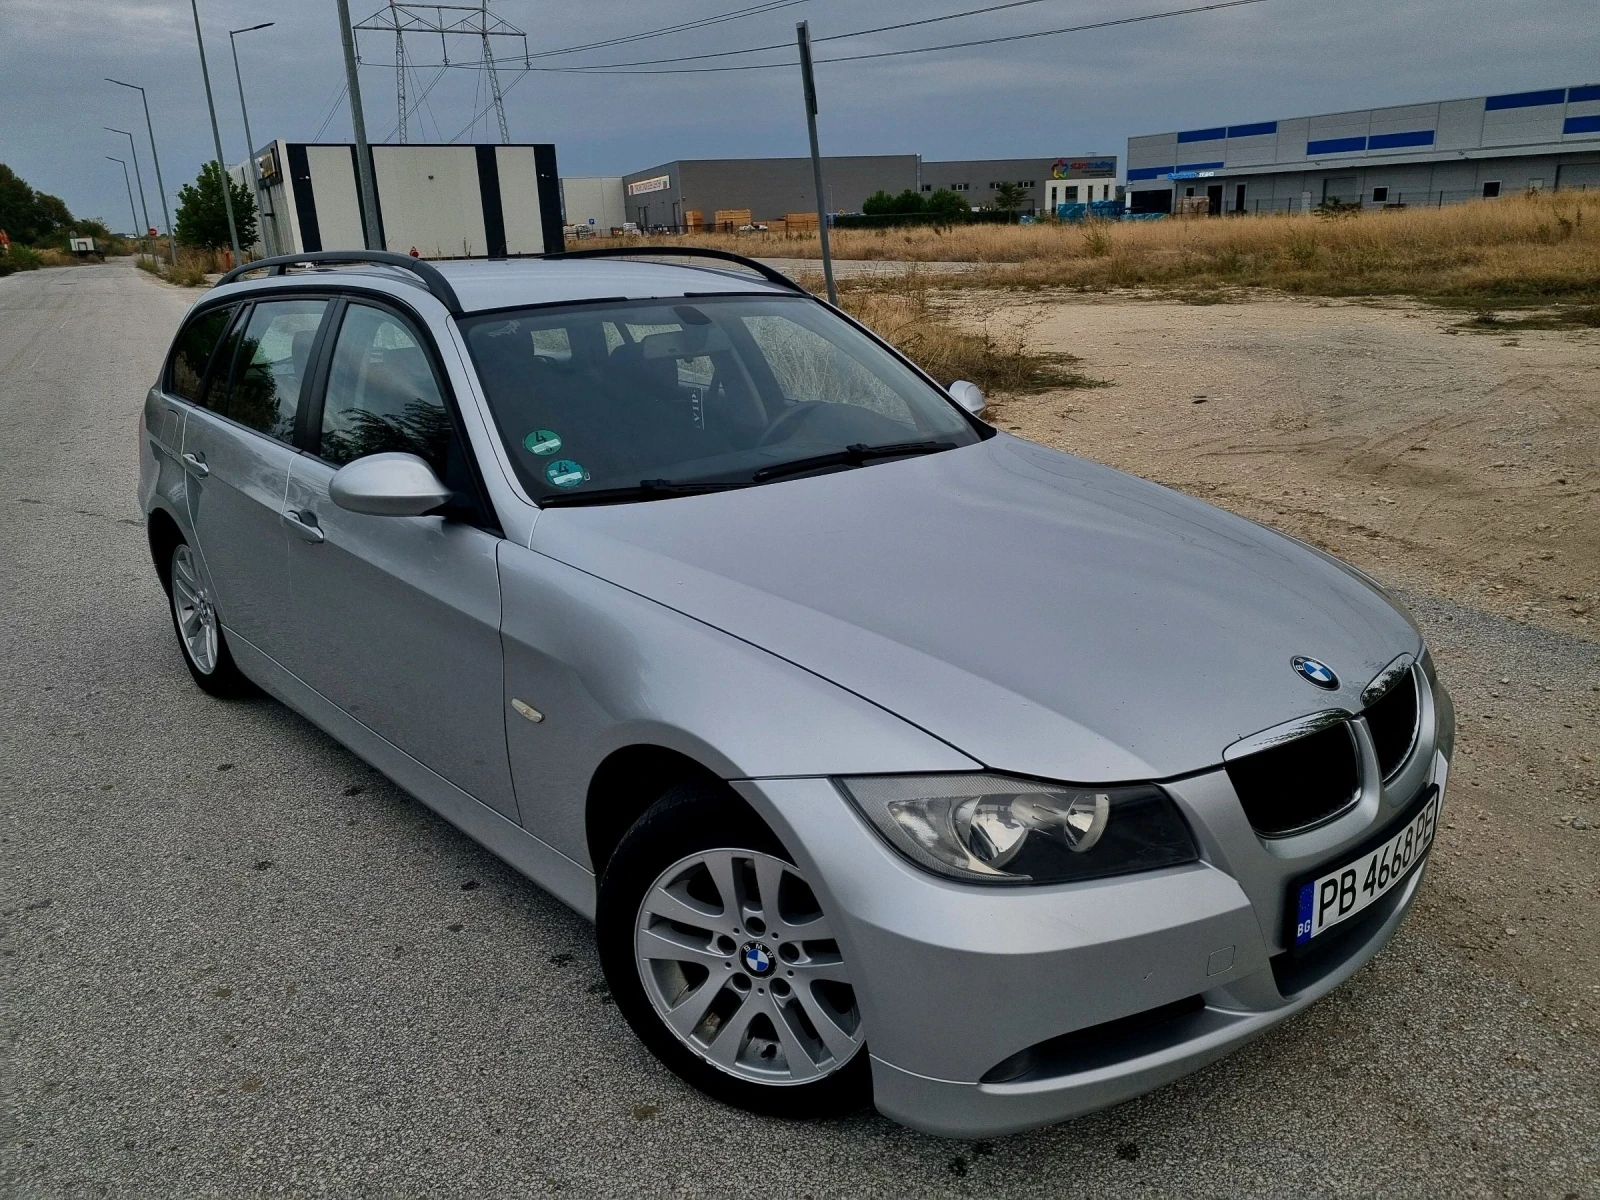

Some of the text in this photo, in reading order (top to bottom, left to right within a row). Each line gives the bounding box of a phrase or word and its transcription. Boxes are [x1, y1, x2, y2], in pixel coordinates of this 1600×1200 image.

[535, 431, 547, 443] 4
[558, 462, 569, 473] 4
[1317, 800, 1435, 929] PB 4668 PE
[1296, 919, 1311, 938] BG
[743, 943, 774, 959] BMW
